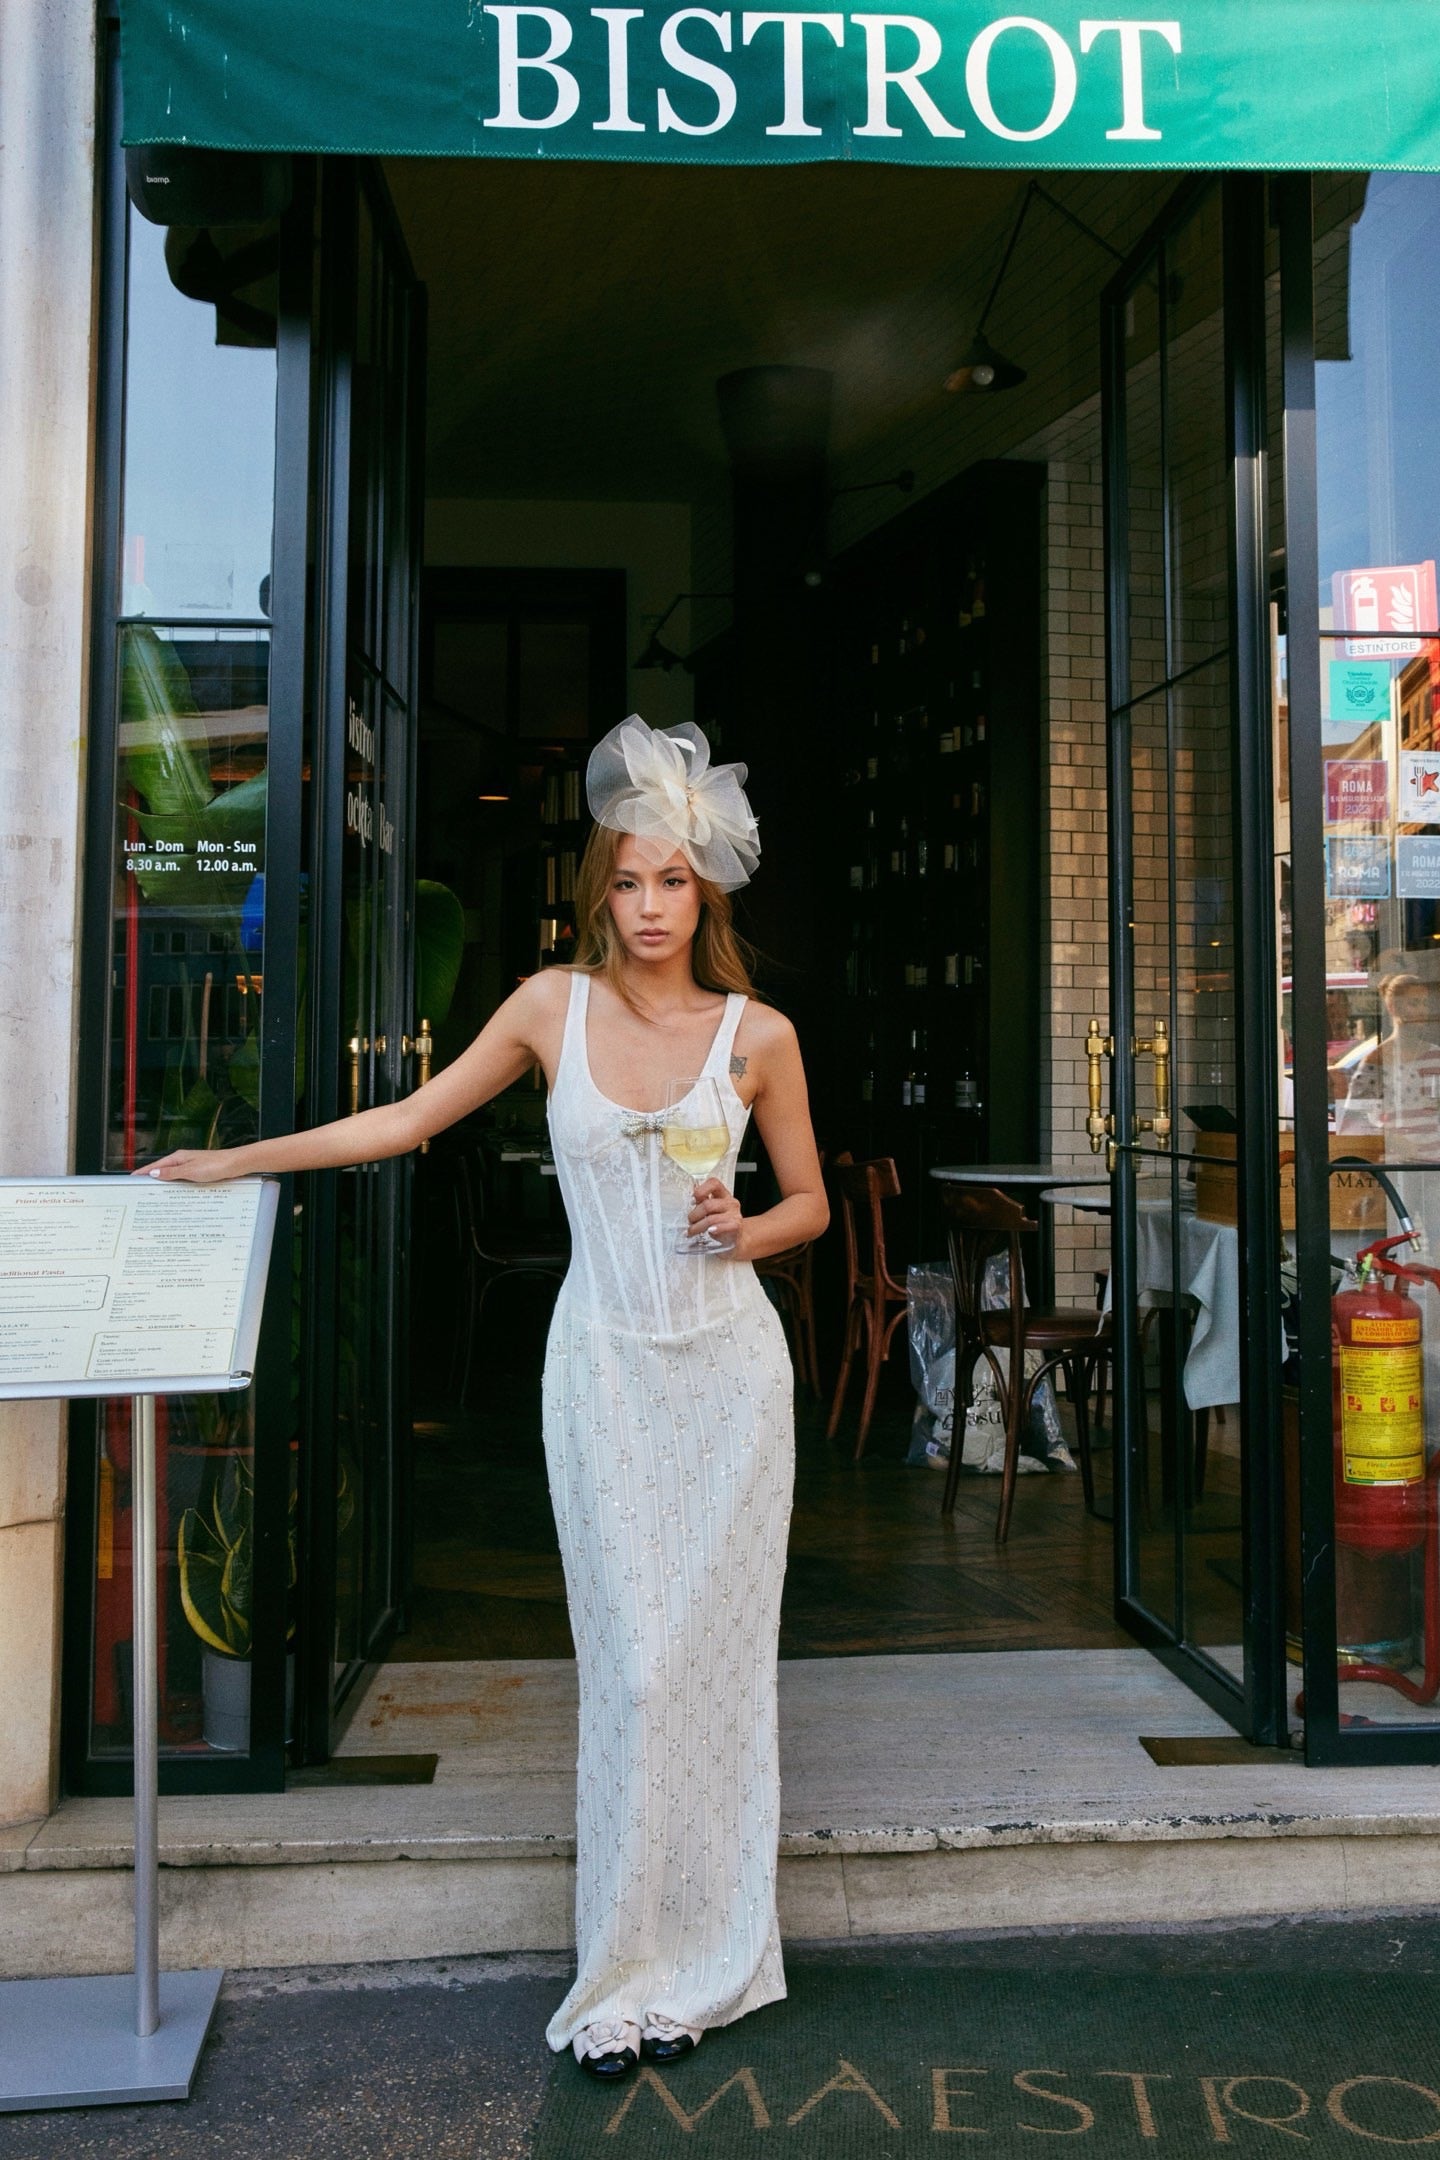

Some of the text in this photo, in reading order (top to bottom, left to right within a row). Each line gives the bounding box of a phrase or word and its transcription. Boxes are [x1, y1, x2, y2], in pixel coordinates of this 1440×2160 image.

[483, 4, 1184, 142] BISTROT
[1349, 641, 1417, 654] ESTINTORE
[1342, 780, 1373, 793] ROMA
[380, 802, 394, 856] Bar
[124, 840, 146, 852] Lun
[156, 840, 184, 852] Dom
[197, 841, 225, 853] Mon
[234, 841, 257, 853] Sun
[126, 859, 181, 872] 8.30 a.m.
[197, 859, 257, 872] 12.00 a.m.
[1338, 865, 1380, 878] ROMA
[605, 2060, 1440, 2146] MAESTRO
